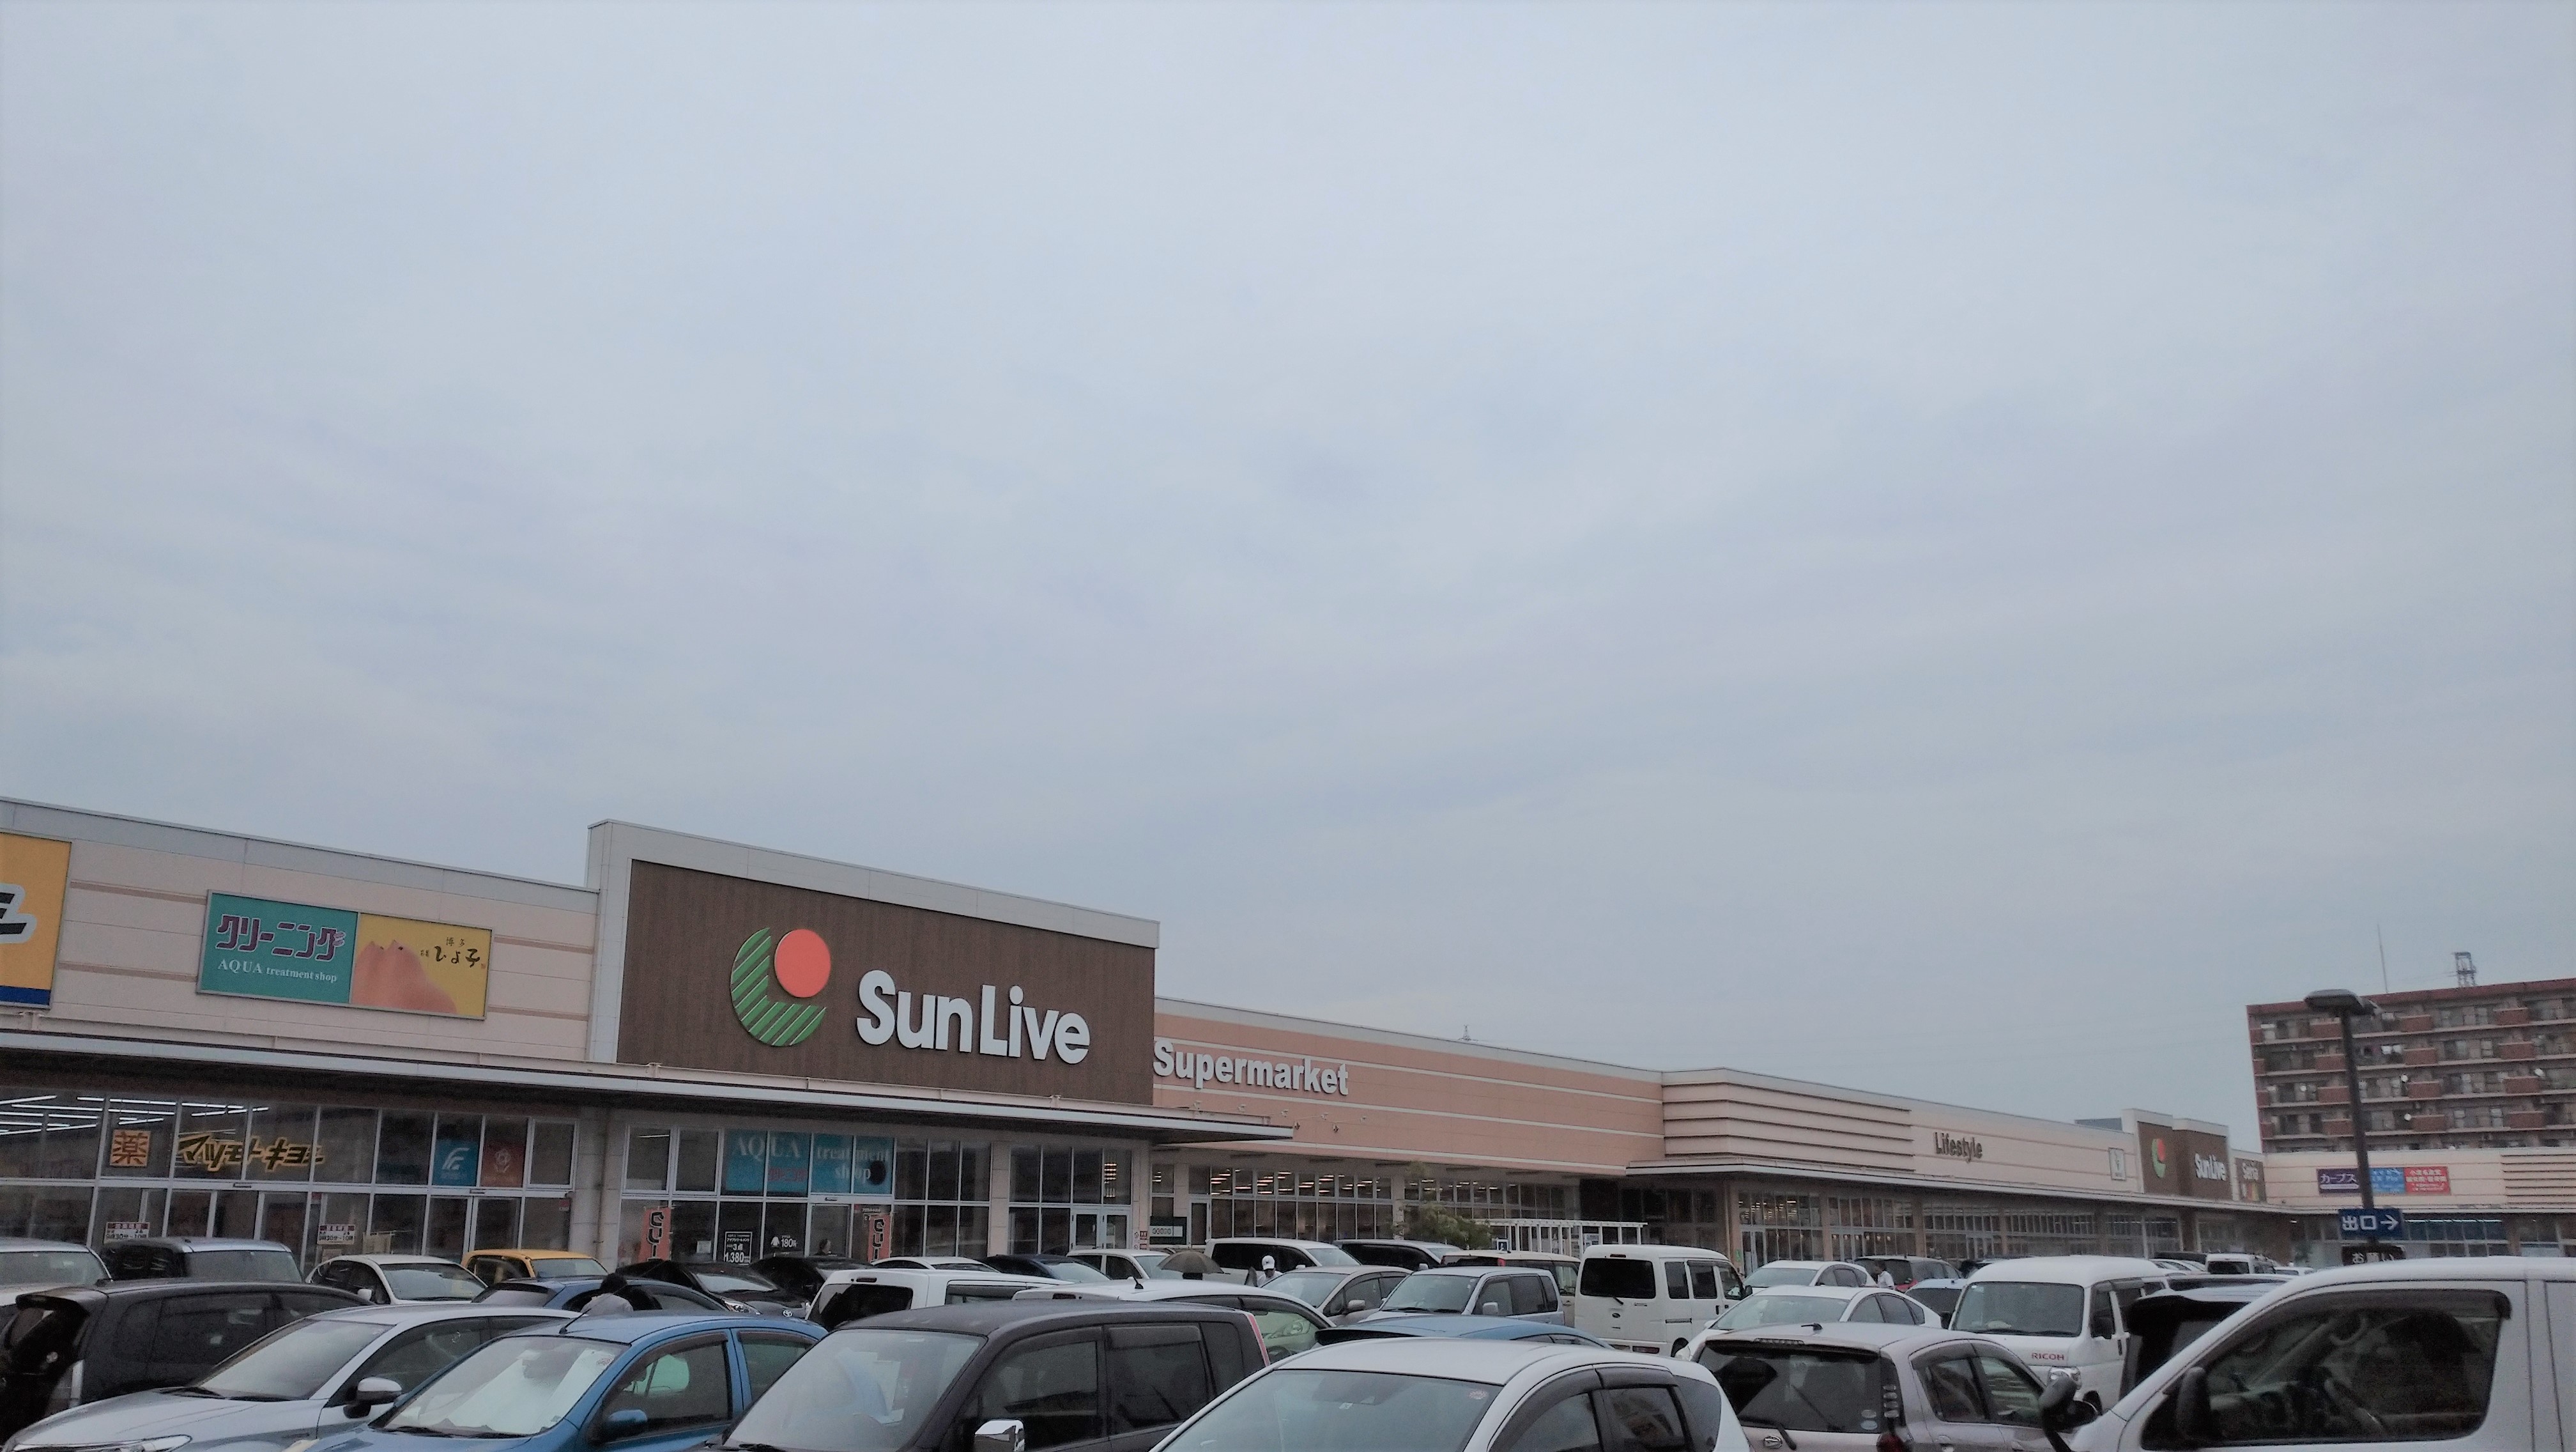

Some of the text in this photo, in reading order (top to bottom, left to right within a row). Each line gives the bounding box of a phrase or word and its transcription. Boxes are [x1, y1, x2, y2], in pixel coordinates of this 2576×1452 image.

[215, 914, 346, 962] クリーニング
[218, 959, 337, 984] AQUA treatment shop
[434, 946, 480, 968] ひよ子
[856, 969, 1091, 1065] SunLive
[1153, 1039, 1349, 1096] Supermarket
[112, 1131, 148, 1165] 薬
[1933, 1132, 1983, 1163] Lifestyle
[2195, 1153, 2227, 1182] SunLive
[2342, 1215, 2377, 1231] 出口
[2031, 1352, 2065, 1361] RICOH
